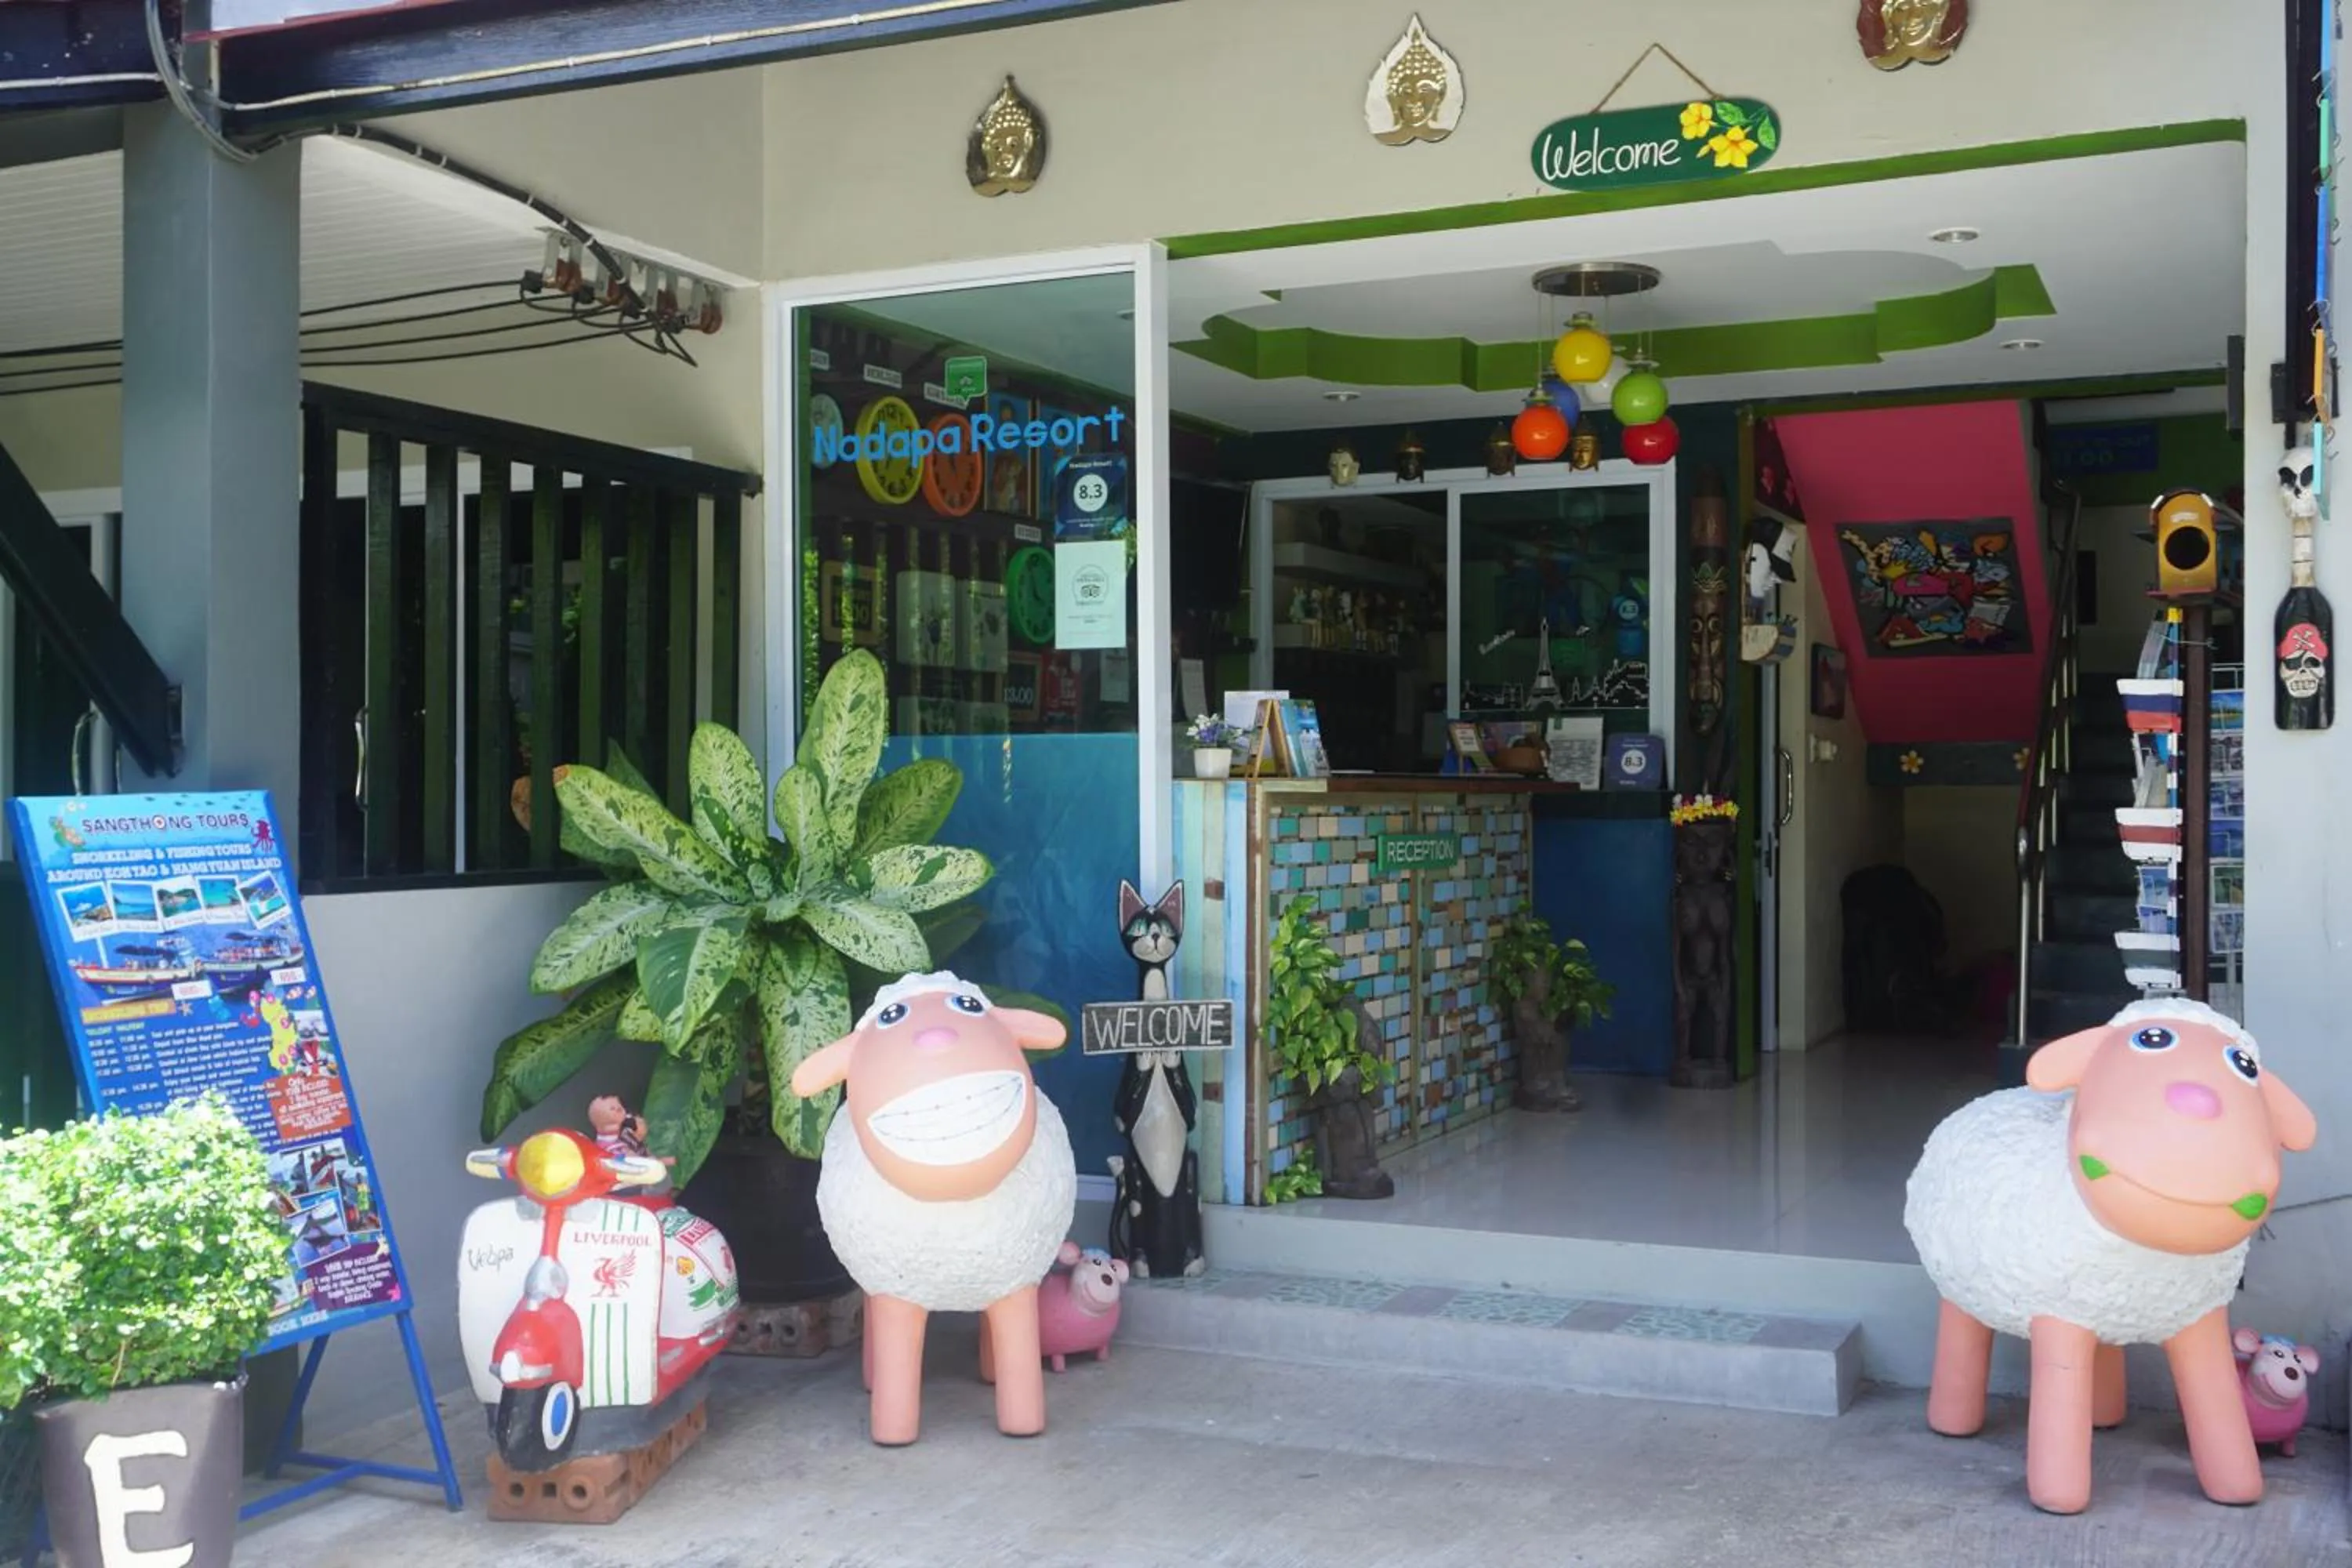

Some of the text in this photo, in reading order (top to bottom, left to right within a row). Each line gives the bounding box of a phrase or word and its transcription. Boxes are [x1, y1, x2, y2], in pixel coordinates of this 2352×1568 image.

[1542, 127, 1681, 181] Welcome
[813, 405, 1124, 468] Nadapa Resort
[1079, 484, 1103, 499] 8.3
[82, 813, 249, 833] SANGTHONG TOURS
[1387, 839, 1454, 862] RECEPTION
[1091, 1004, 1225, 1050] WELCOME
[573, 1231, 652, 1247] LIVERPOOL
[83, 1430, 194, 1568] E
